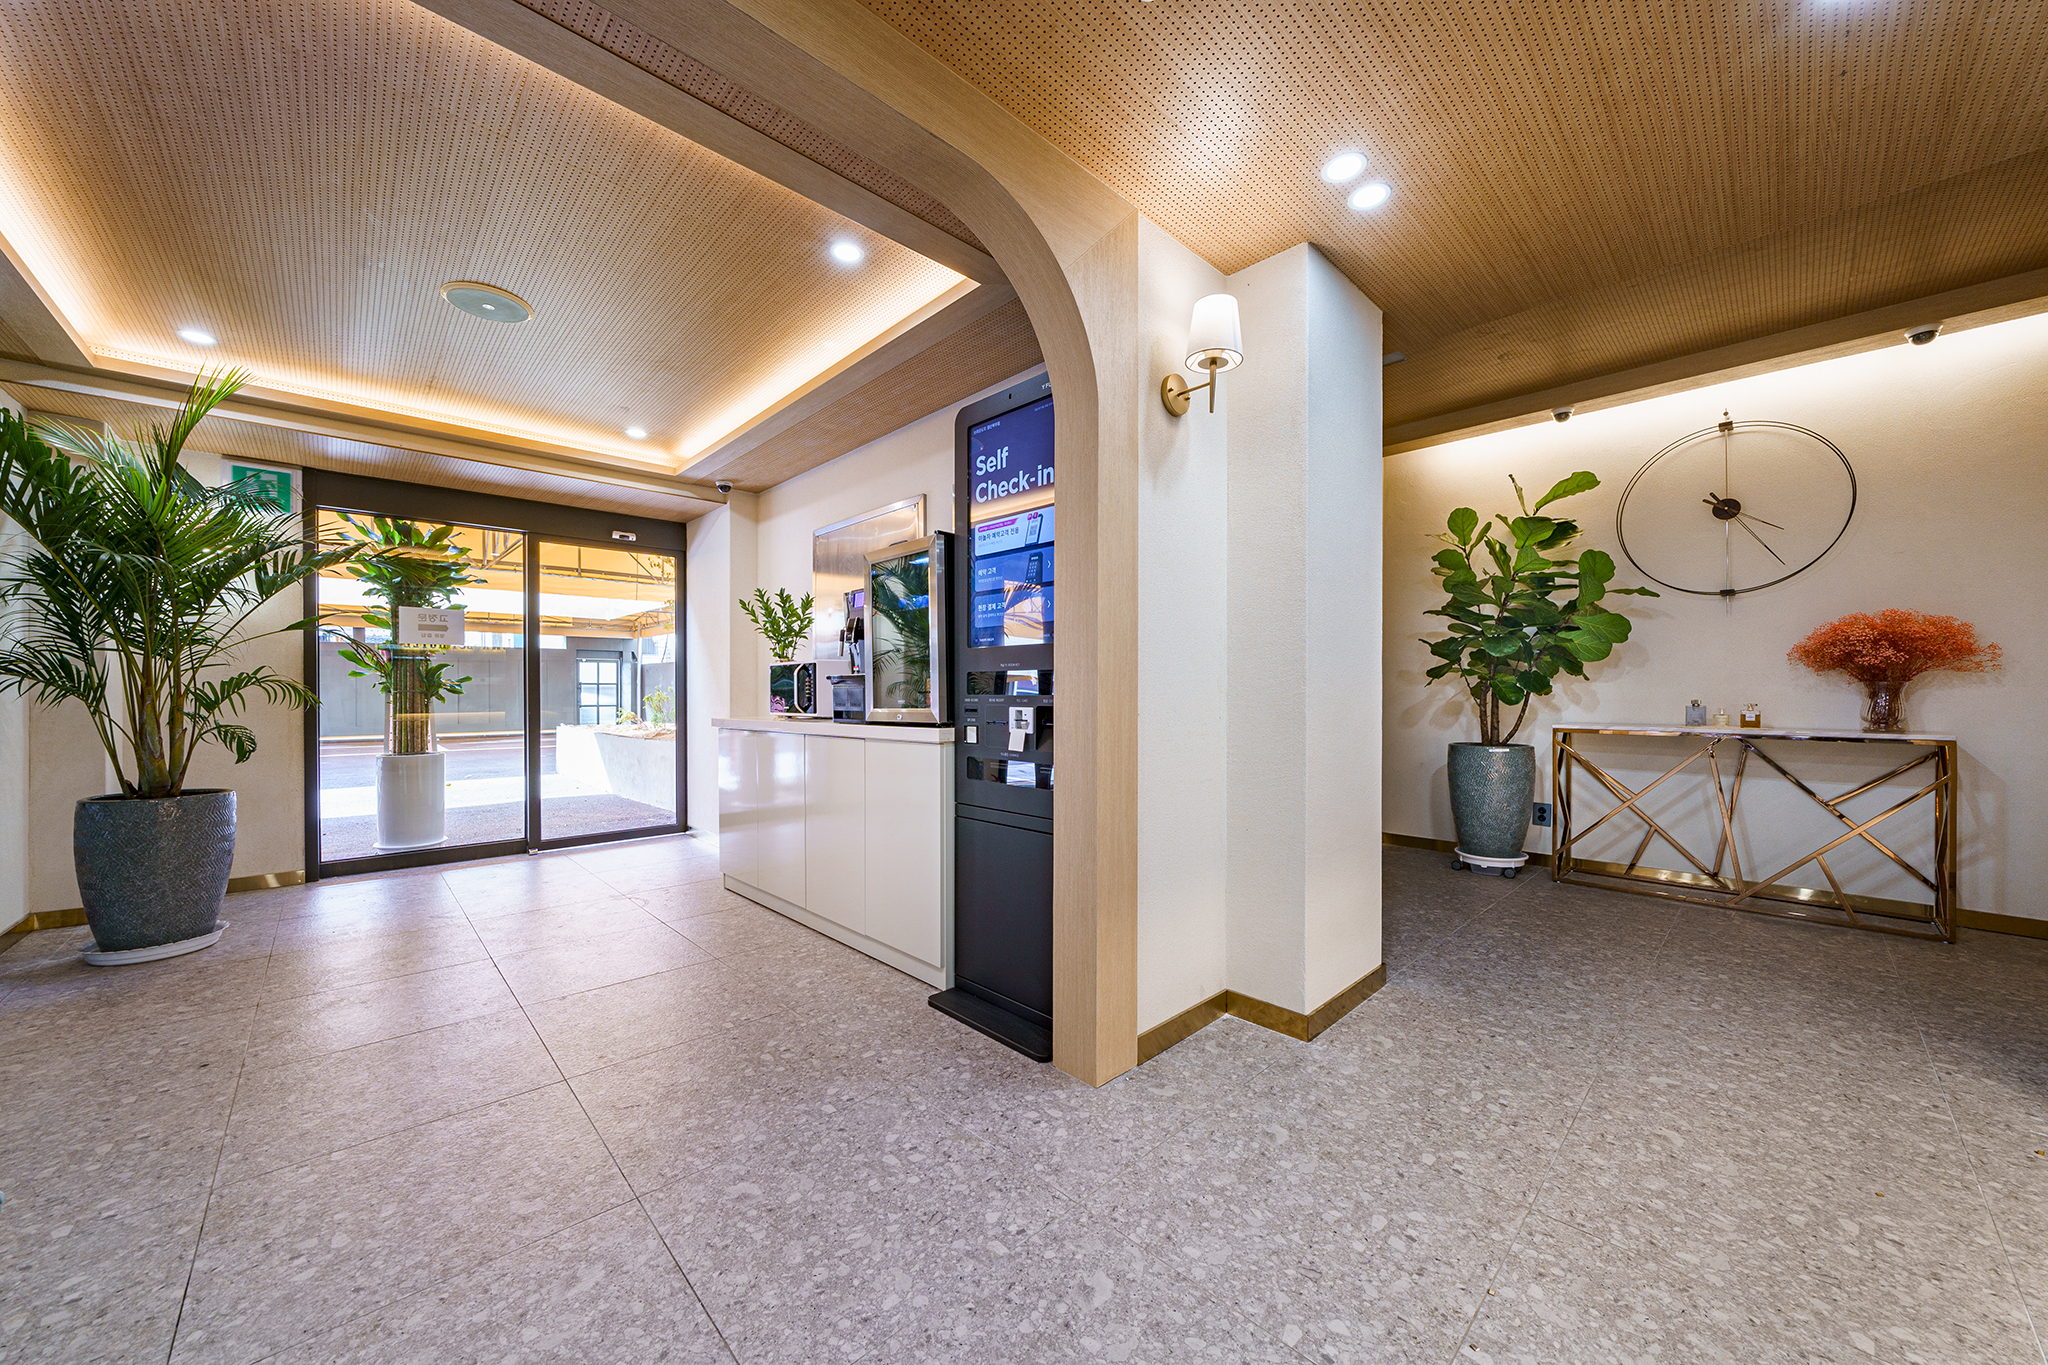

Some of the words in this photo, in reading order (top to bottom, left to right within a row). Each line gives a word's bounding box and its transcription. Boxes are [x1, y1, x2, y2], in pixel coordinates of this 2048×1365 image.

[976, 446, 1009, 475] Self
[976, 464, 1054, 503] Check-in
[978, 533, 991, 542] 야놀자
[987, 566, 997, 575] 고객
